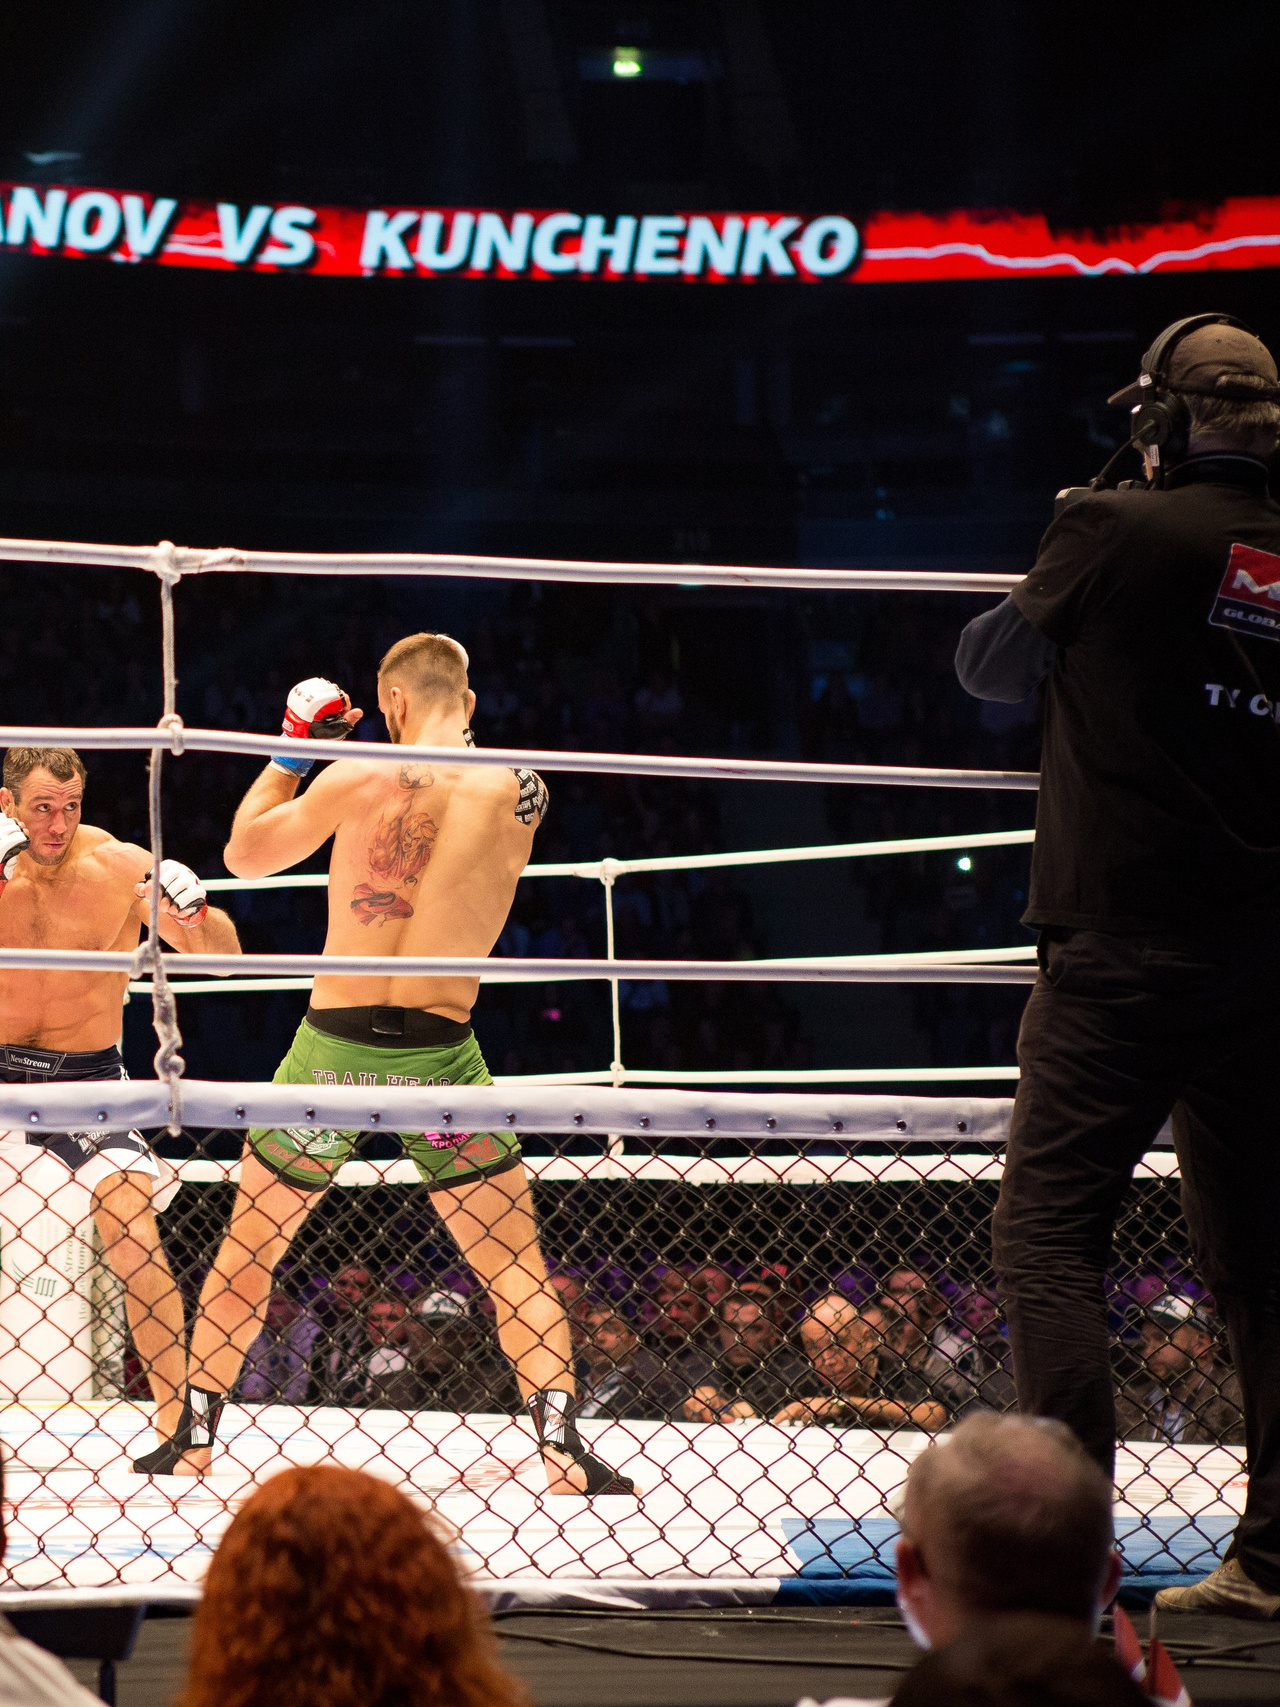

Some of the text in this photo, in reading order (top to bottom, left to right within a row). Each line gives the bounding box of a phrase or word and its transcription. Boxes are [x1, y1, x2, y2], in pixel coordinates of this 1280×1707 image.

[217, 201, 318, 266] VS
[358, 210, 859, 277] KUNCHENKO
[1223, 608, 1280, 629] GLOB
[10, 1054, 51, 1069] NewStream
